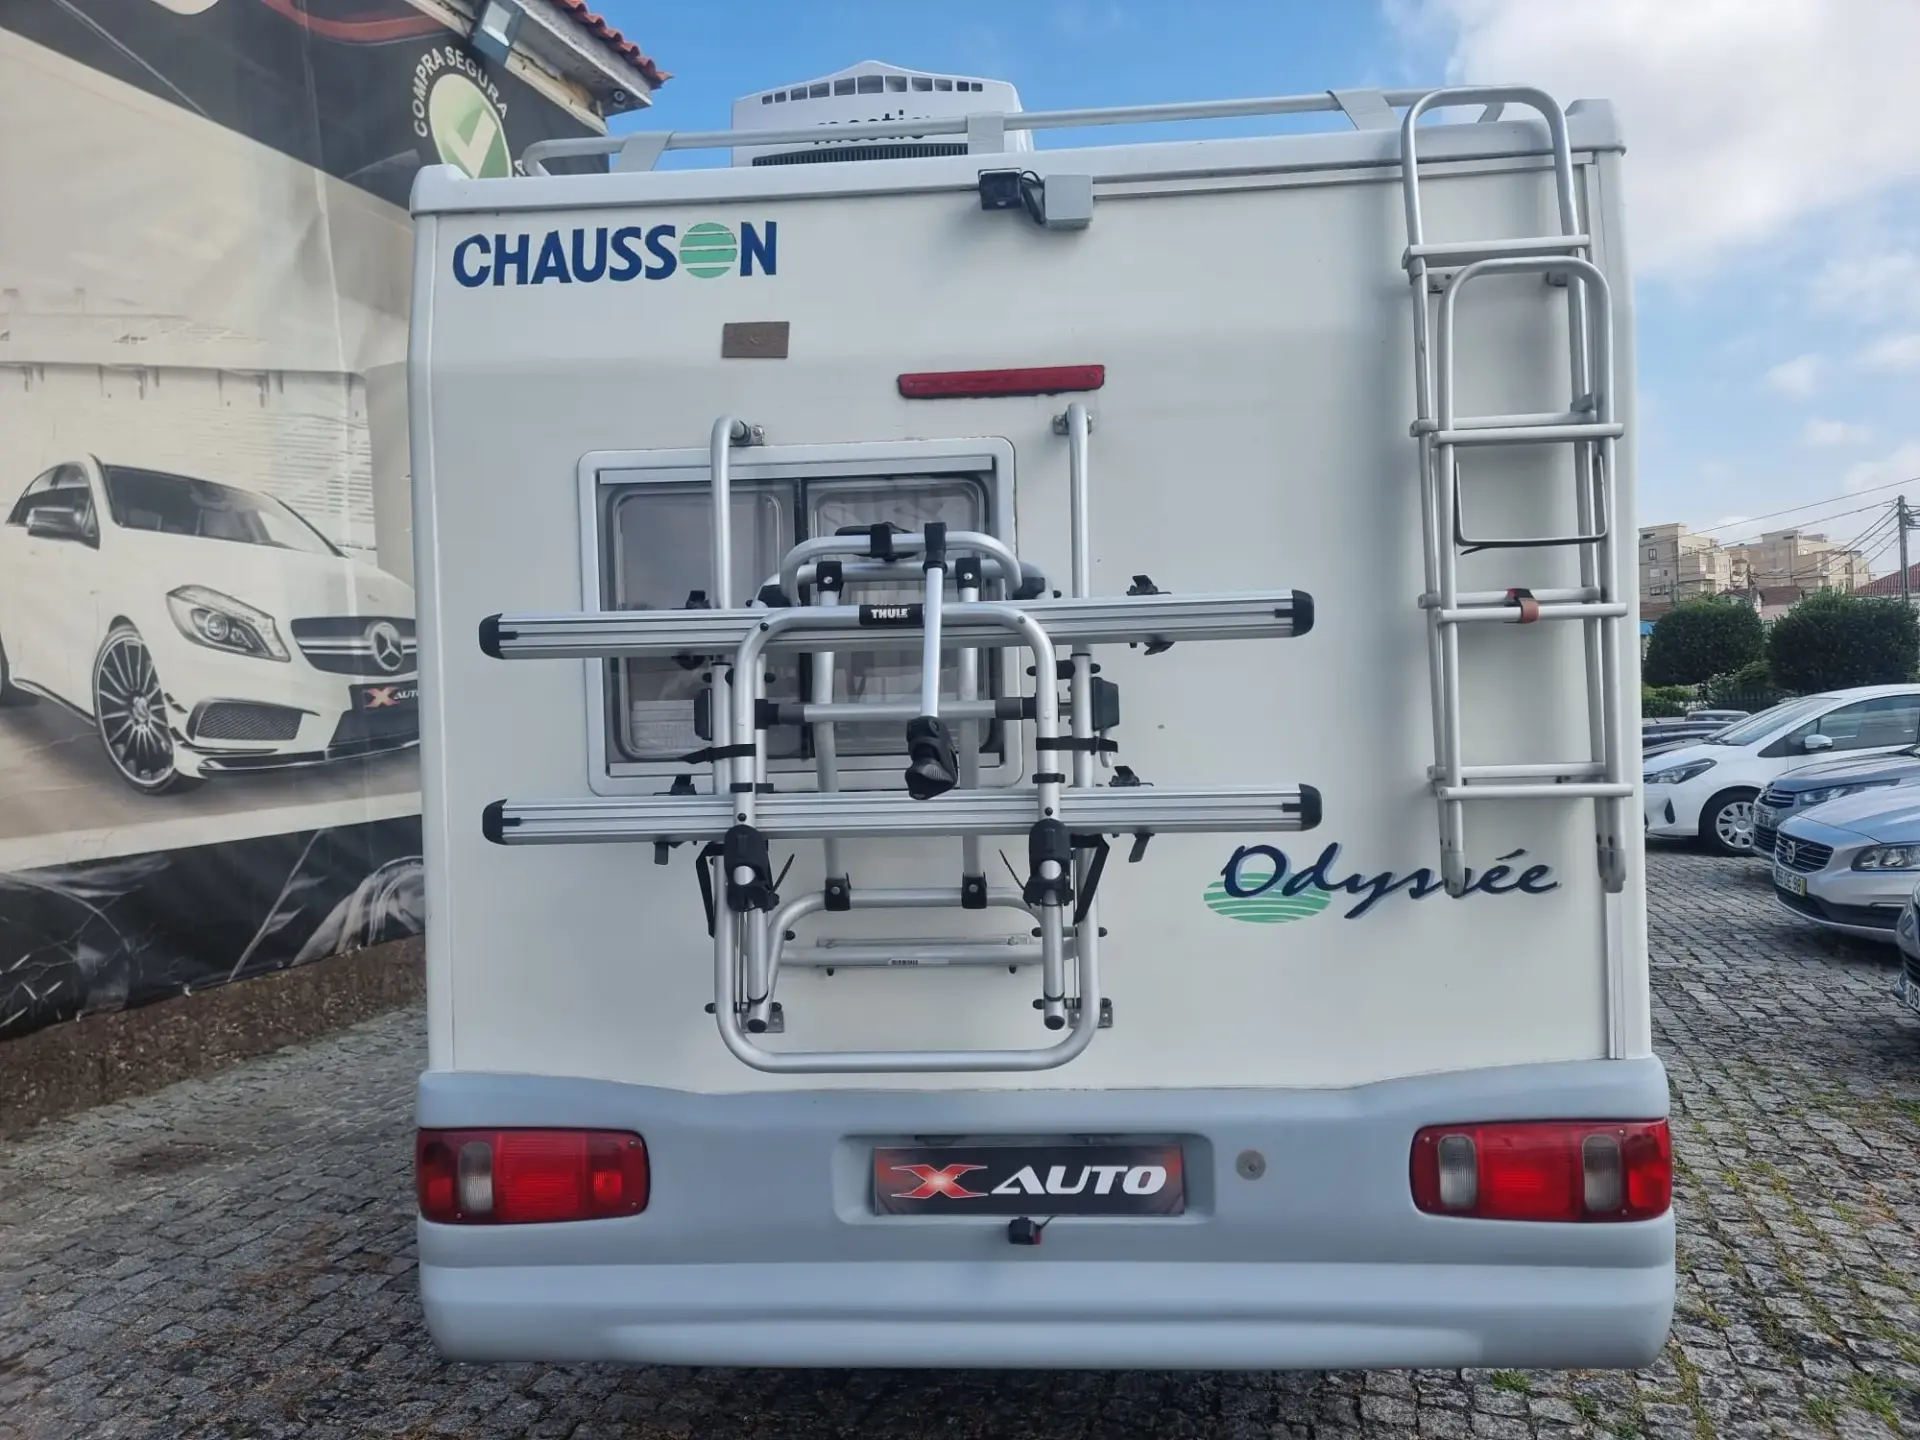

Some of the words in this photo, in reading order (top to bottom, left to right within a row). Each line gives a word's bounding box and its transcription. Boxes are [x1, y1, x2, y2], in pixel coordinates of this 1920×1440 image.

[412, 48, 446, 137] COMPRA
[444, 45, 508, 120] SEGURA
[452, 220, 778, 288] CHAUSSON
[870, 607, 908, 619] THULE
[890, 1163, 989, 1199] X
[990, 1165, 1168, 1195] AUTO
